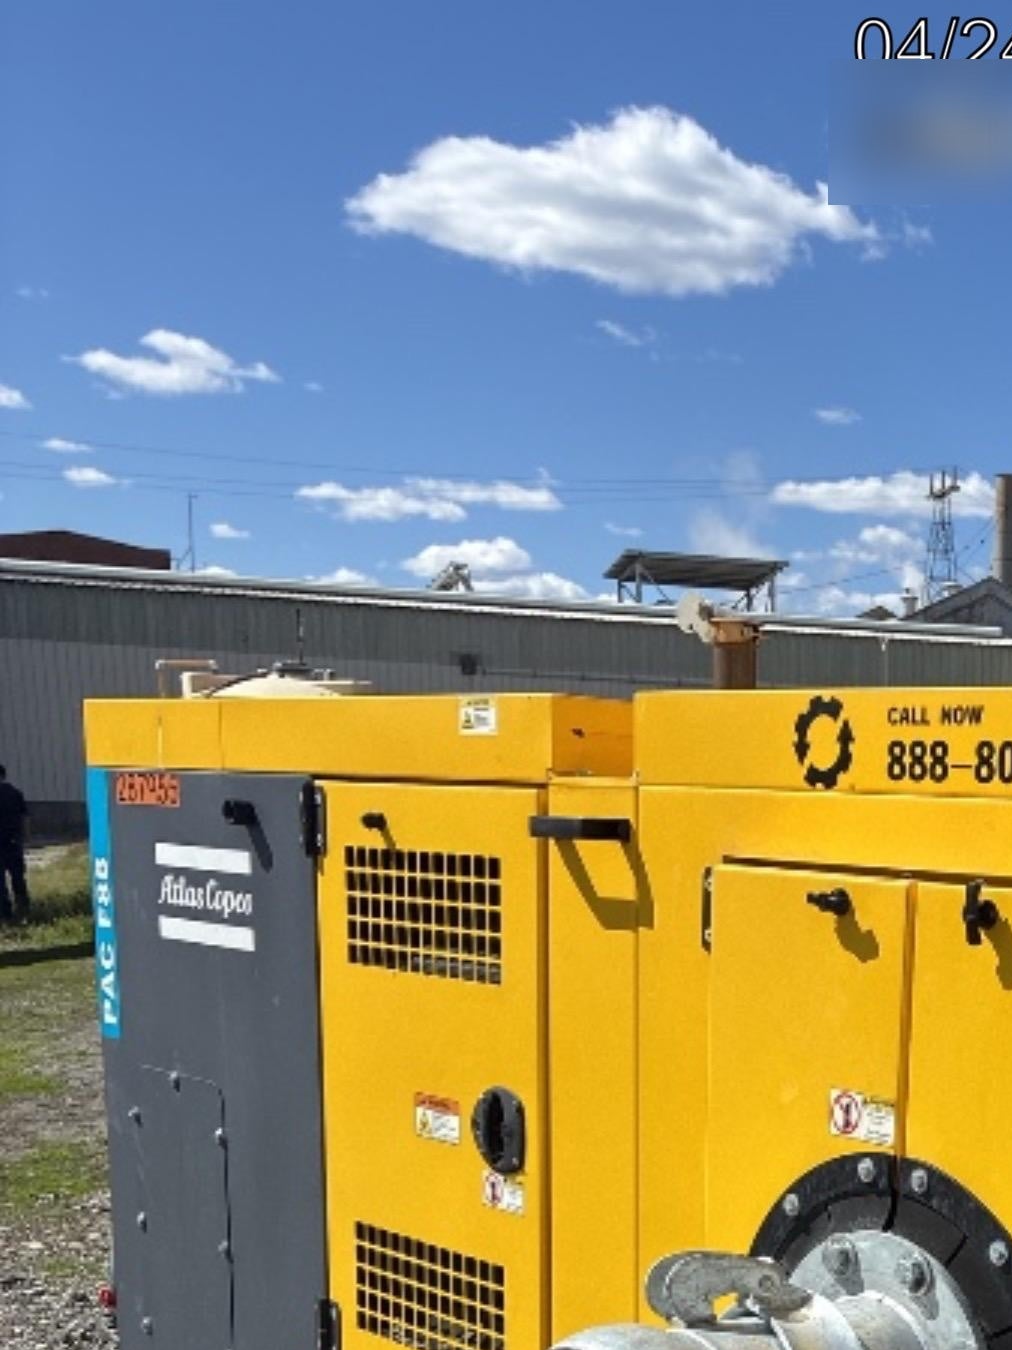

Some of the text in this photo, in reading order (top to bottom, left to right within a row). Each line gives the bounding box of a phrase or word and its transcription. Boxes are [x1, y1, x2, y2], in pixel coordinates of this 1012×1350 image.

[887, 705, 984, 726] CALL NOW
[158, 873, 204, 910] Atlas
[101, 941, 117, 1025] PAC
